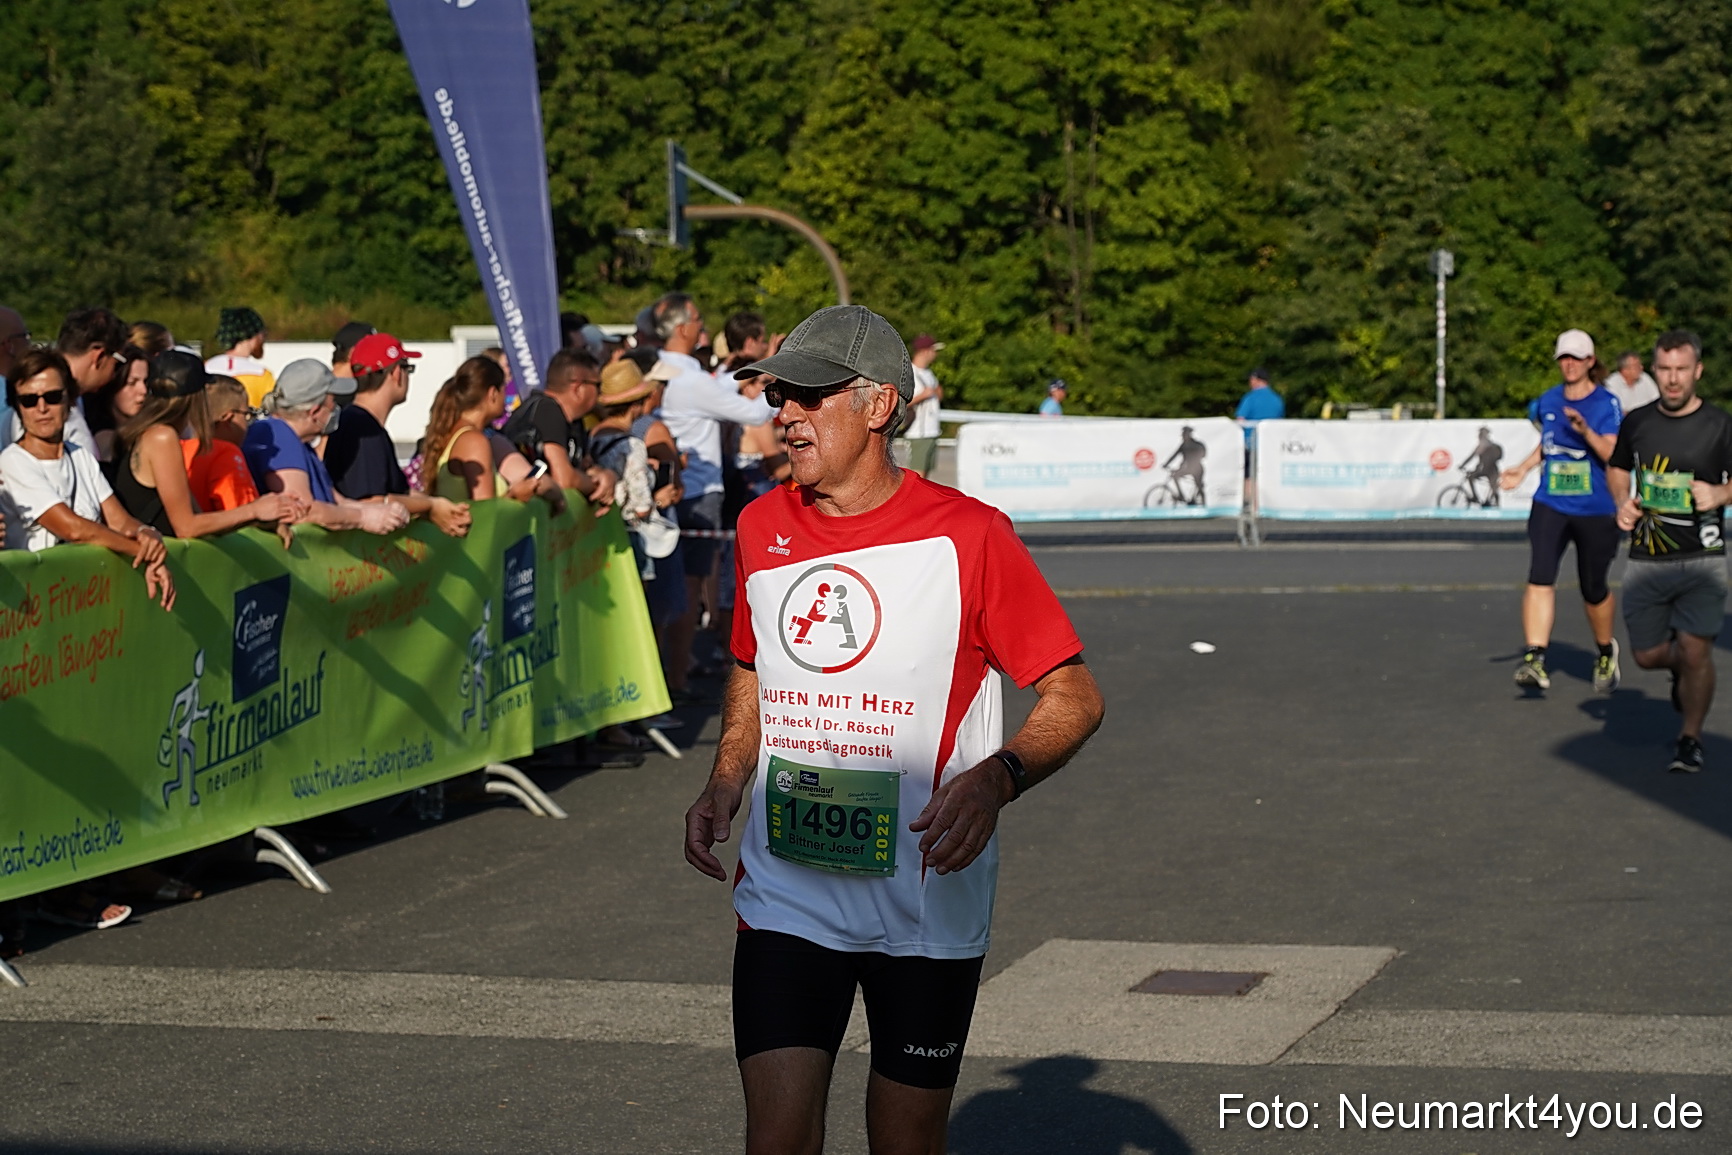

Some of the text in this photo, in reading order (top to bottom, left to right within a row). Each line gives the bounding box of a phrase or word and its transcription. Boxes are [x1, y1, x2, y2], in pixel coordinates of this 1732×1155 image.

[767, 545, 791, 556] erima
[48, 575, 111, 623] Firmen
[58, 608, 125, 684] länger!
[206, 650, 326, 767] firmenlauf
[818, 693, 852, 710] MIT
[862, 693, 915, 716] HERZ
[823, 719, 843, 732] Dr.
[847, 721, 894, 737] Röschl
[765, 733, 893, 760] Leistungsdiagnostik
[207, 754, 263, 793] neumarkt
[794, 783, 835, 794] Firmenlauf
[772, 803, 782, 839] RUN
[784, 797, 873, 841] 1496
[788, 832, 866, 855] Bittner Josef
[875, 813, 890, 862] 2022
[903, 1043, 950, 1058] JAKO
